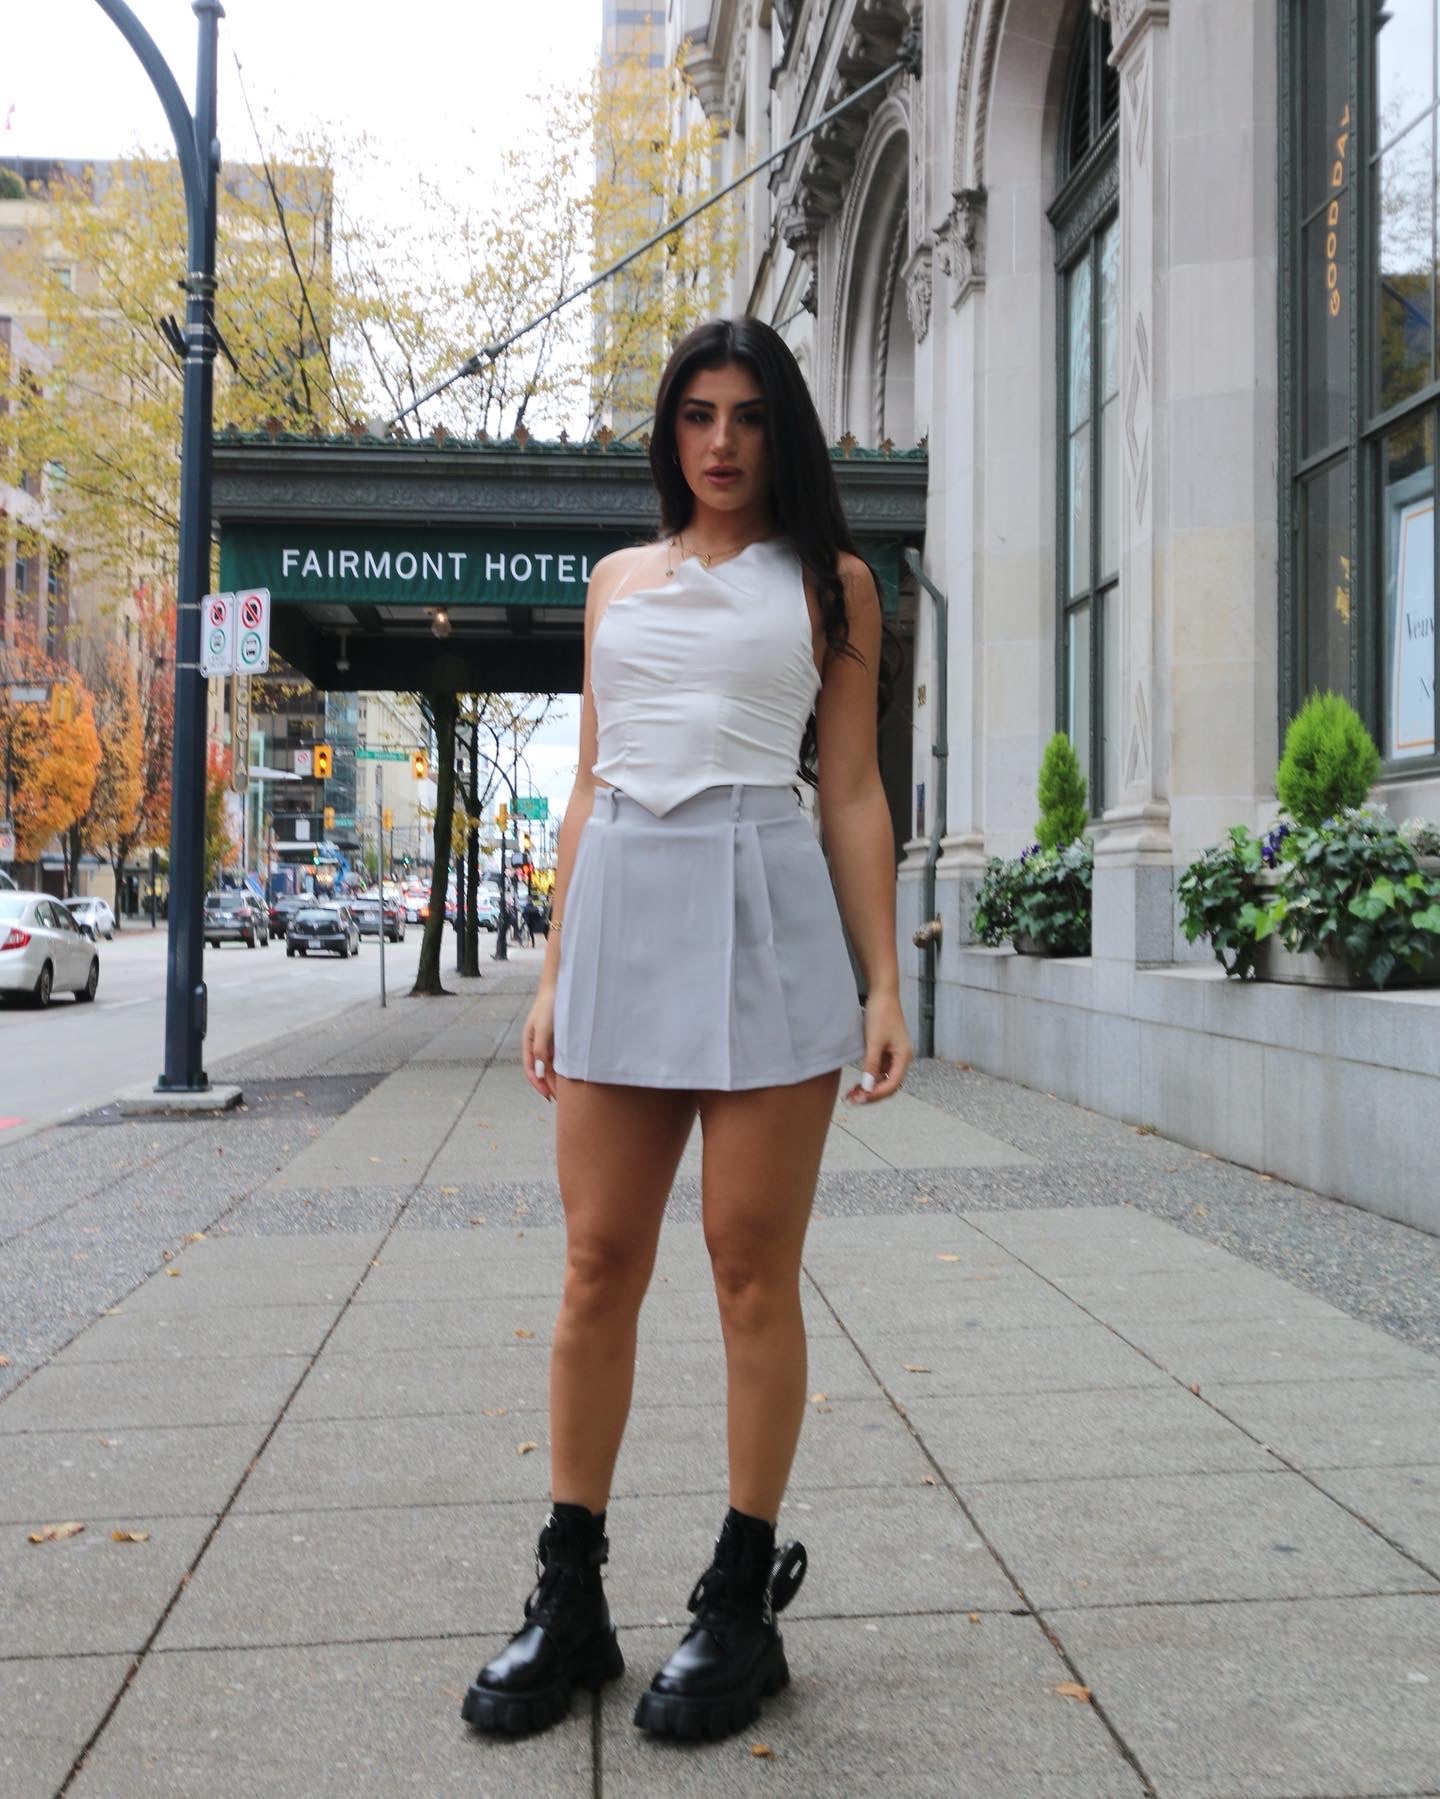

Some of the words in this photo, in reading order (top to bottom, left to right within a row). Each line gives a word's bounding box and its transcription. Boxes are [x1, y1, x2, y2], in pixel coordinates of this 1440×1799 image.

[1326, 199, 1341, 317] GOOD
[281, 549, 467, 581] FAIRMONT
[485, 552, 592, 583] HOTEL
